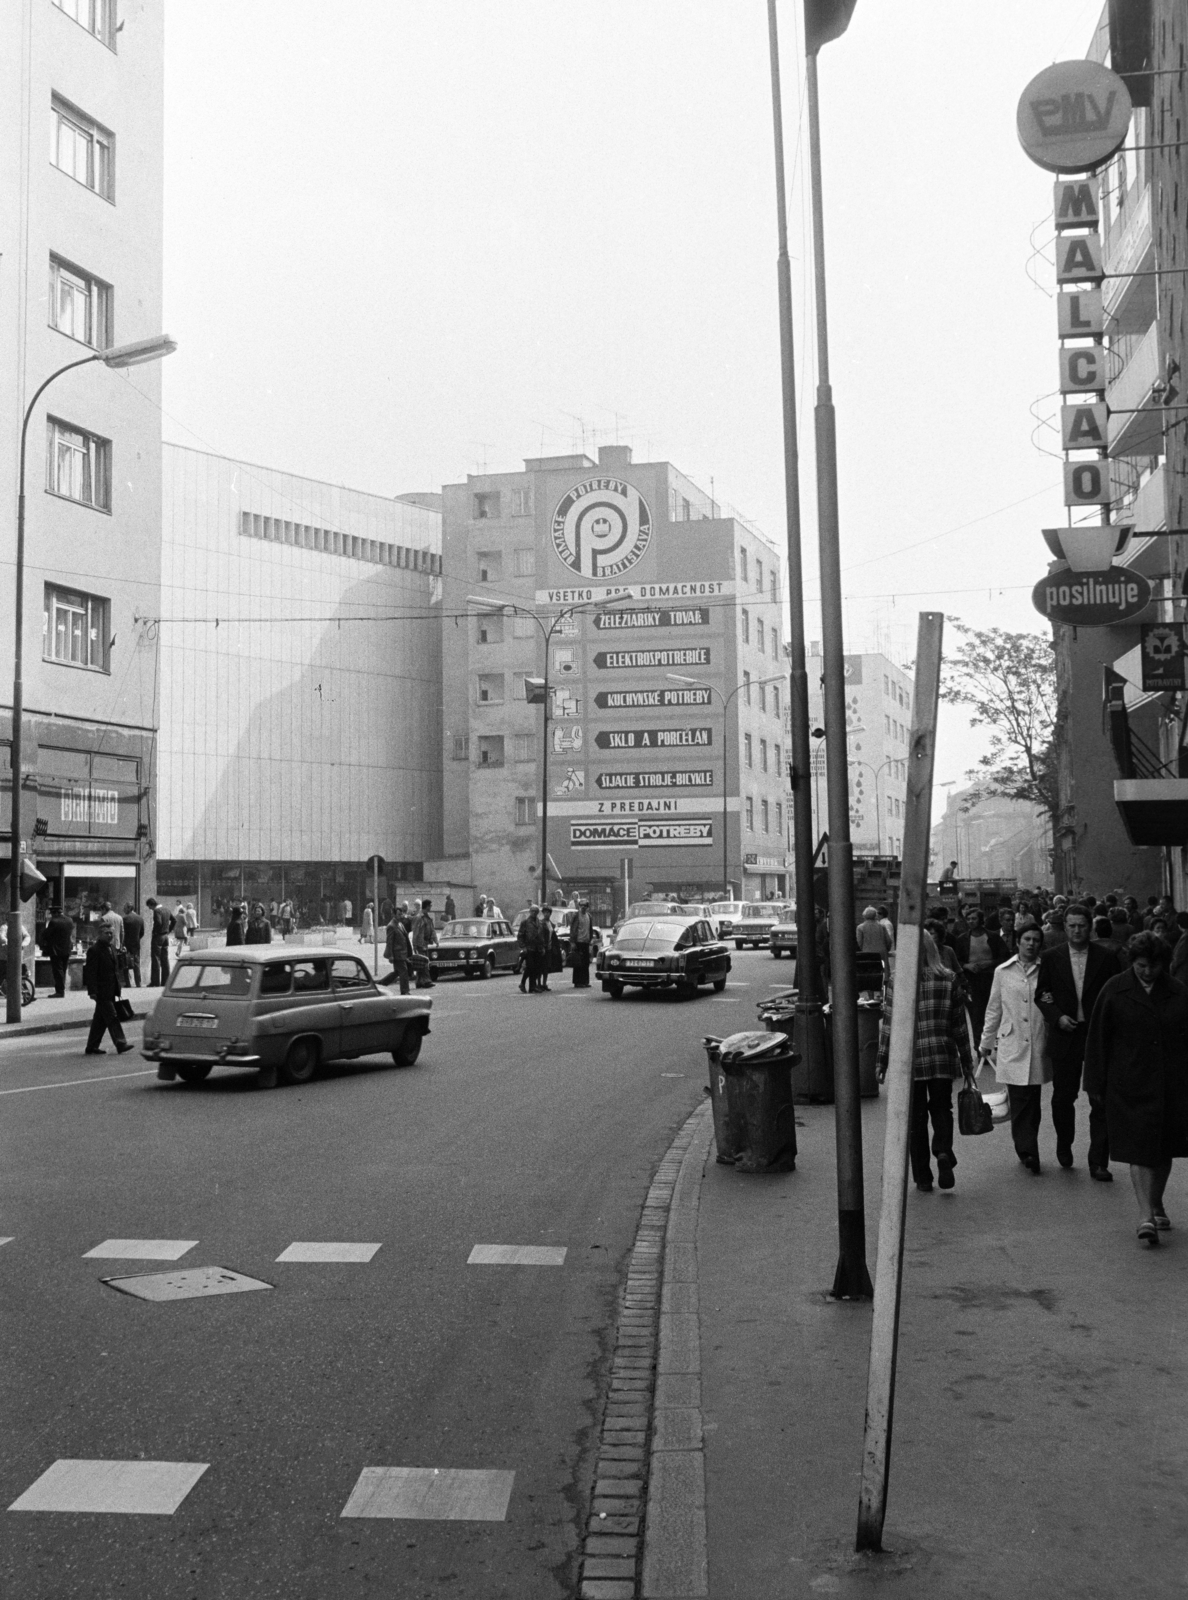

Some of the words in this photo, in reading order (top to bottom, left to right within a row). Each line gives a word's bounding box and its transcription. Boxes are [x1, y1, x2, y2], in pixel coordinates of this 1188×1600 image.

[1062, 183, 1102, 500] MALCAO
[569, 479, 624, 501] POTREBY
[597, 524, 650, 577] BRATISLAVA
[640, 583, 723, 597] DOMACNOST
[1045, 576, 1139, 613] posilňuje
[669, 610, 702, 625] TOVAR
[664, 690, 710, 705] POTREBY
[609, 732, 635, 747] SKLO
[642, 732, 651, 746] A
[598, 802, 605, 812] Z
[611, 800, 678, 812] PREDAJNI
[572, 826, 637, 839] DOMÁCE
[639, 825, 710, 838] POTREBY
